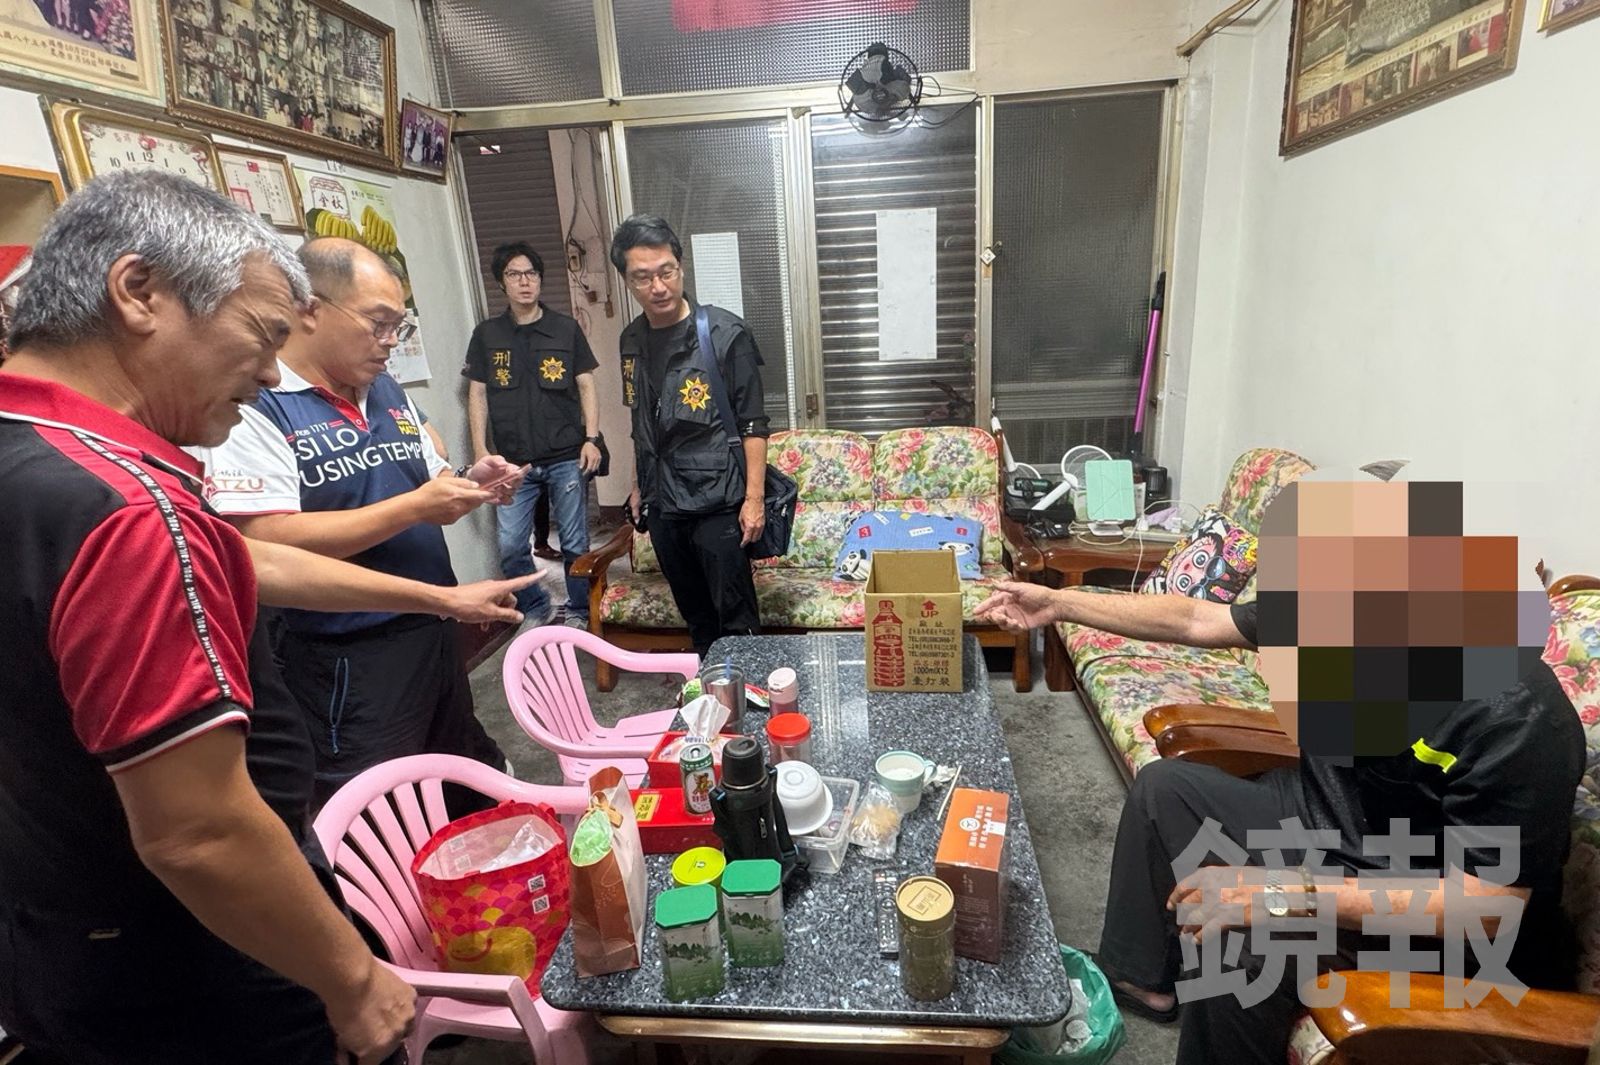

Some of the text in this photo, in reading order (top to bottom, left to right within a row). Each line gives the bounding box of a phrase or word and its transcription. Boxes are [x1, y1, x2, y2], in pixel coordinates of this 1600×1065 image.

[109, 157, 121, 168] 10
[126, 151, 136, 162] 11
[143, 151, 155, 162] 12
[492, 350, 512, 386] 刑警
[623, 358, 635, 404] 刑警
[309, 422, 329, 433] 1717
[321, 428, 359, 452] LO
[174, 535, 190, 563] SAILING
[186, 587, 204, 614] SAILING
[920, 610, 939, 618] UP
[201, 636, 218, 663] SAILING
